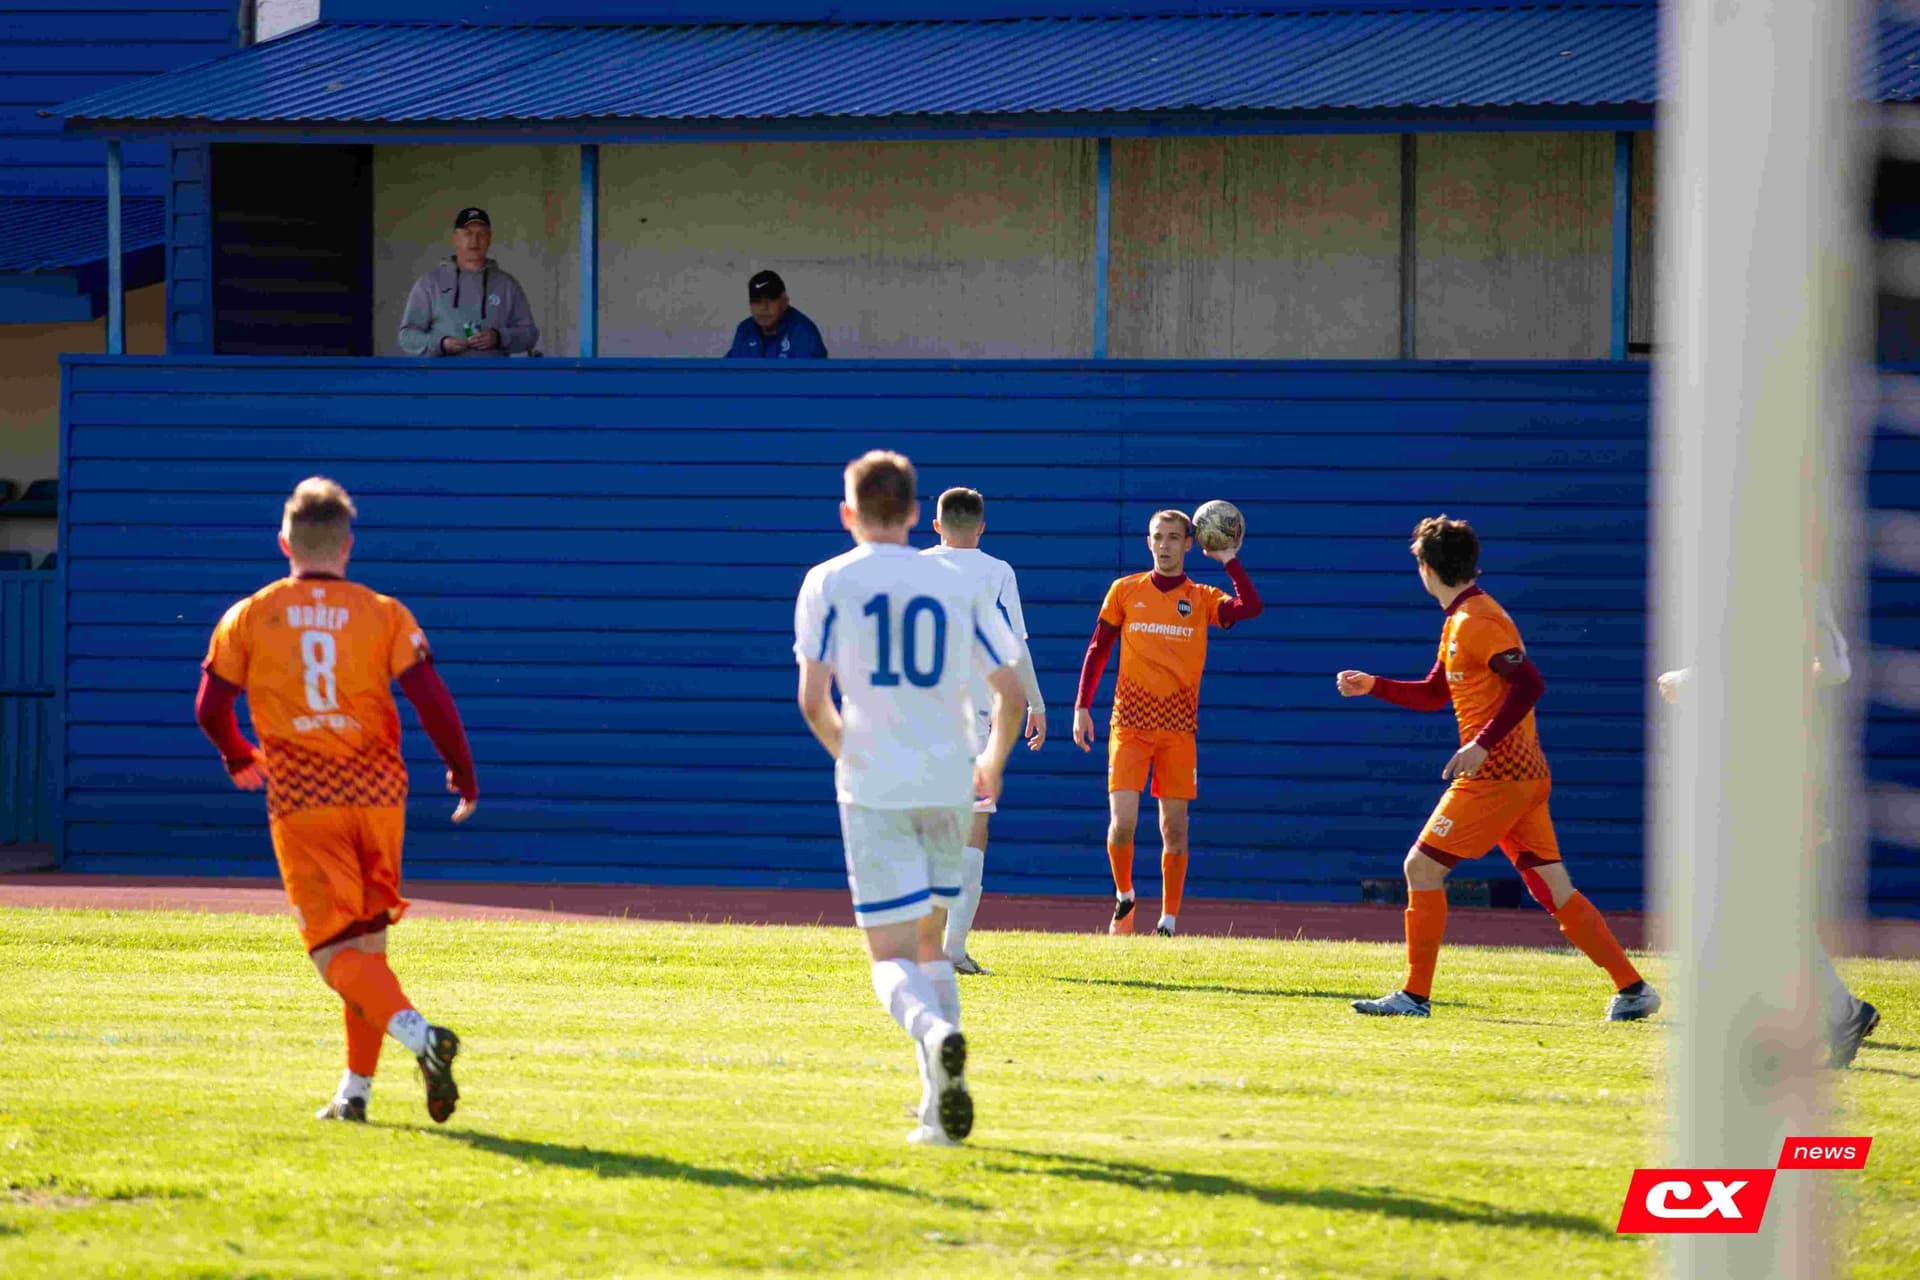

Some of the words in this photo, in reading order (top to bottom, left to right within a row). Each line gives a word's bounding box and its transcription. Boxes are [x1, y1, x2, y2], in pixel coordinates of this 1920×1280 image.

[862, 593, 948, 687] 10
[1129, 622, 1194, 637] ПРОДИНВЕСТ
[301, 629, 340, 711] 8
[1431, 815, 1454, 837] 23
